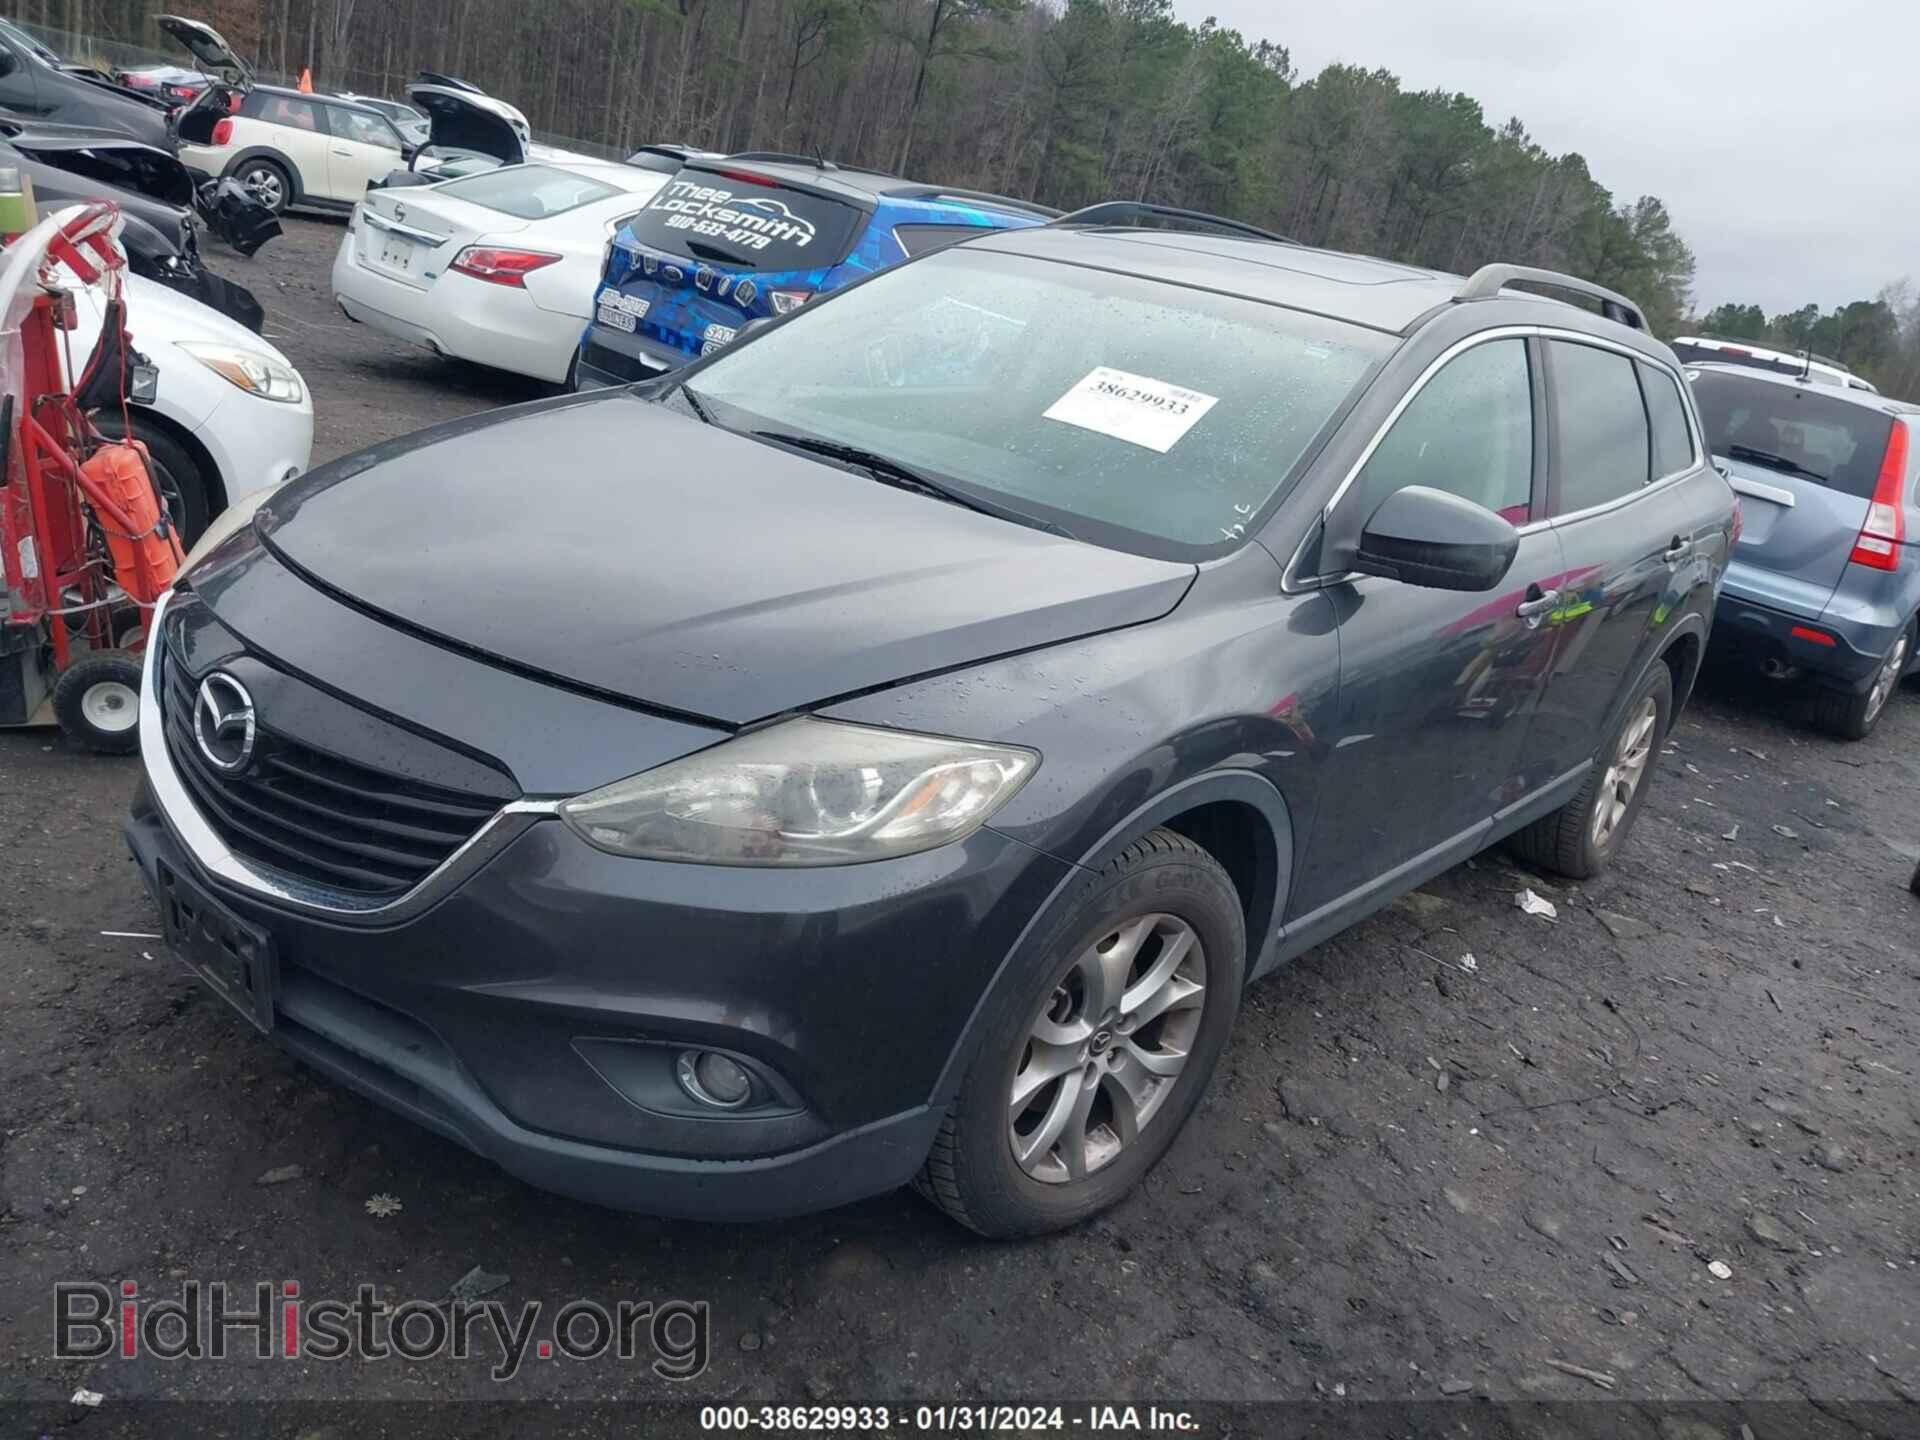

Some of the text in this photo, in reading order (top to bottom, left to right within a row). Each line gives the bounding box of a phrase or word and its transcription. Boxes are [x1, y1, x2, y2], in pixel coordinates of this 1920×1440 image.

[664, 214, 772, 249] 910-633-4779
[600, 307, 635, 330] INESS
[1089, 381, 1189, 415] 38629933
